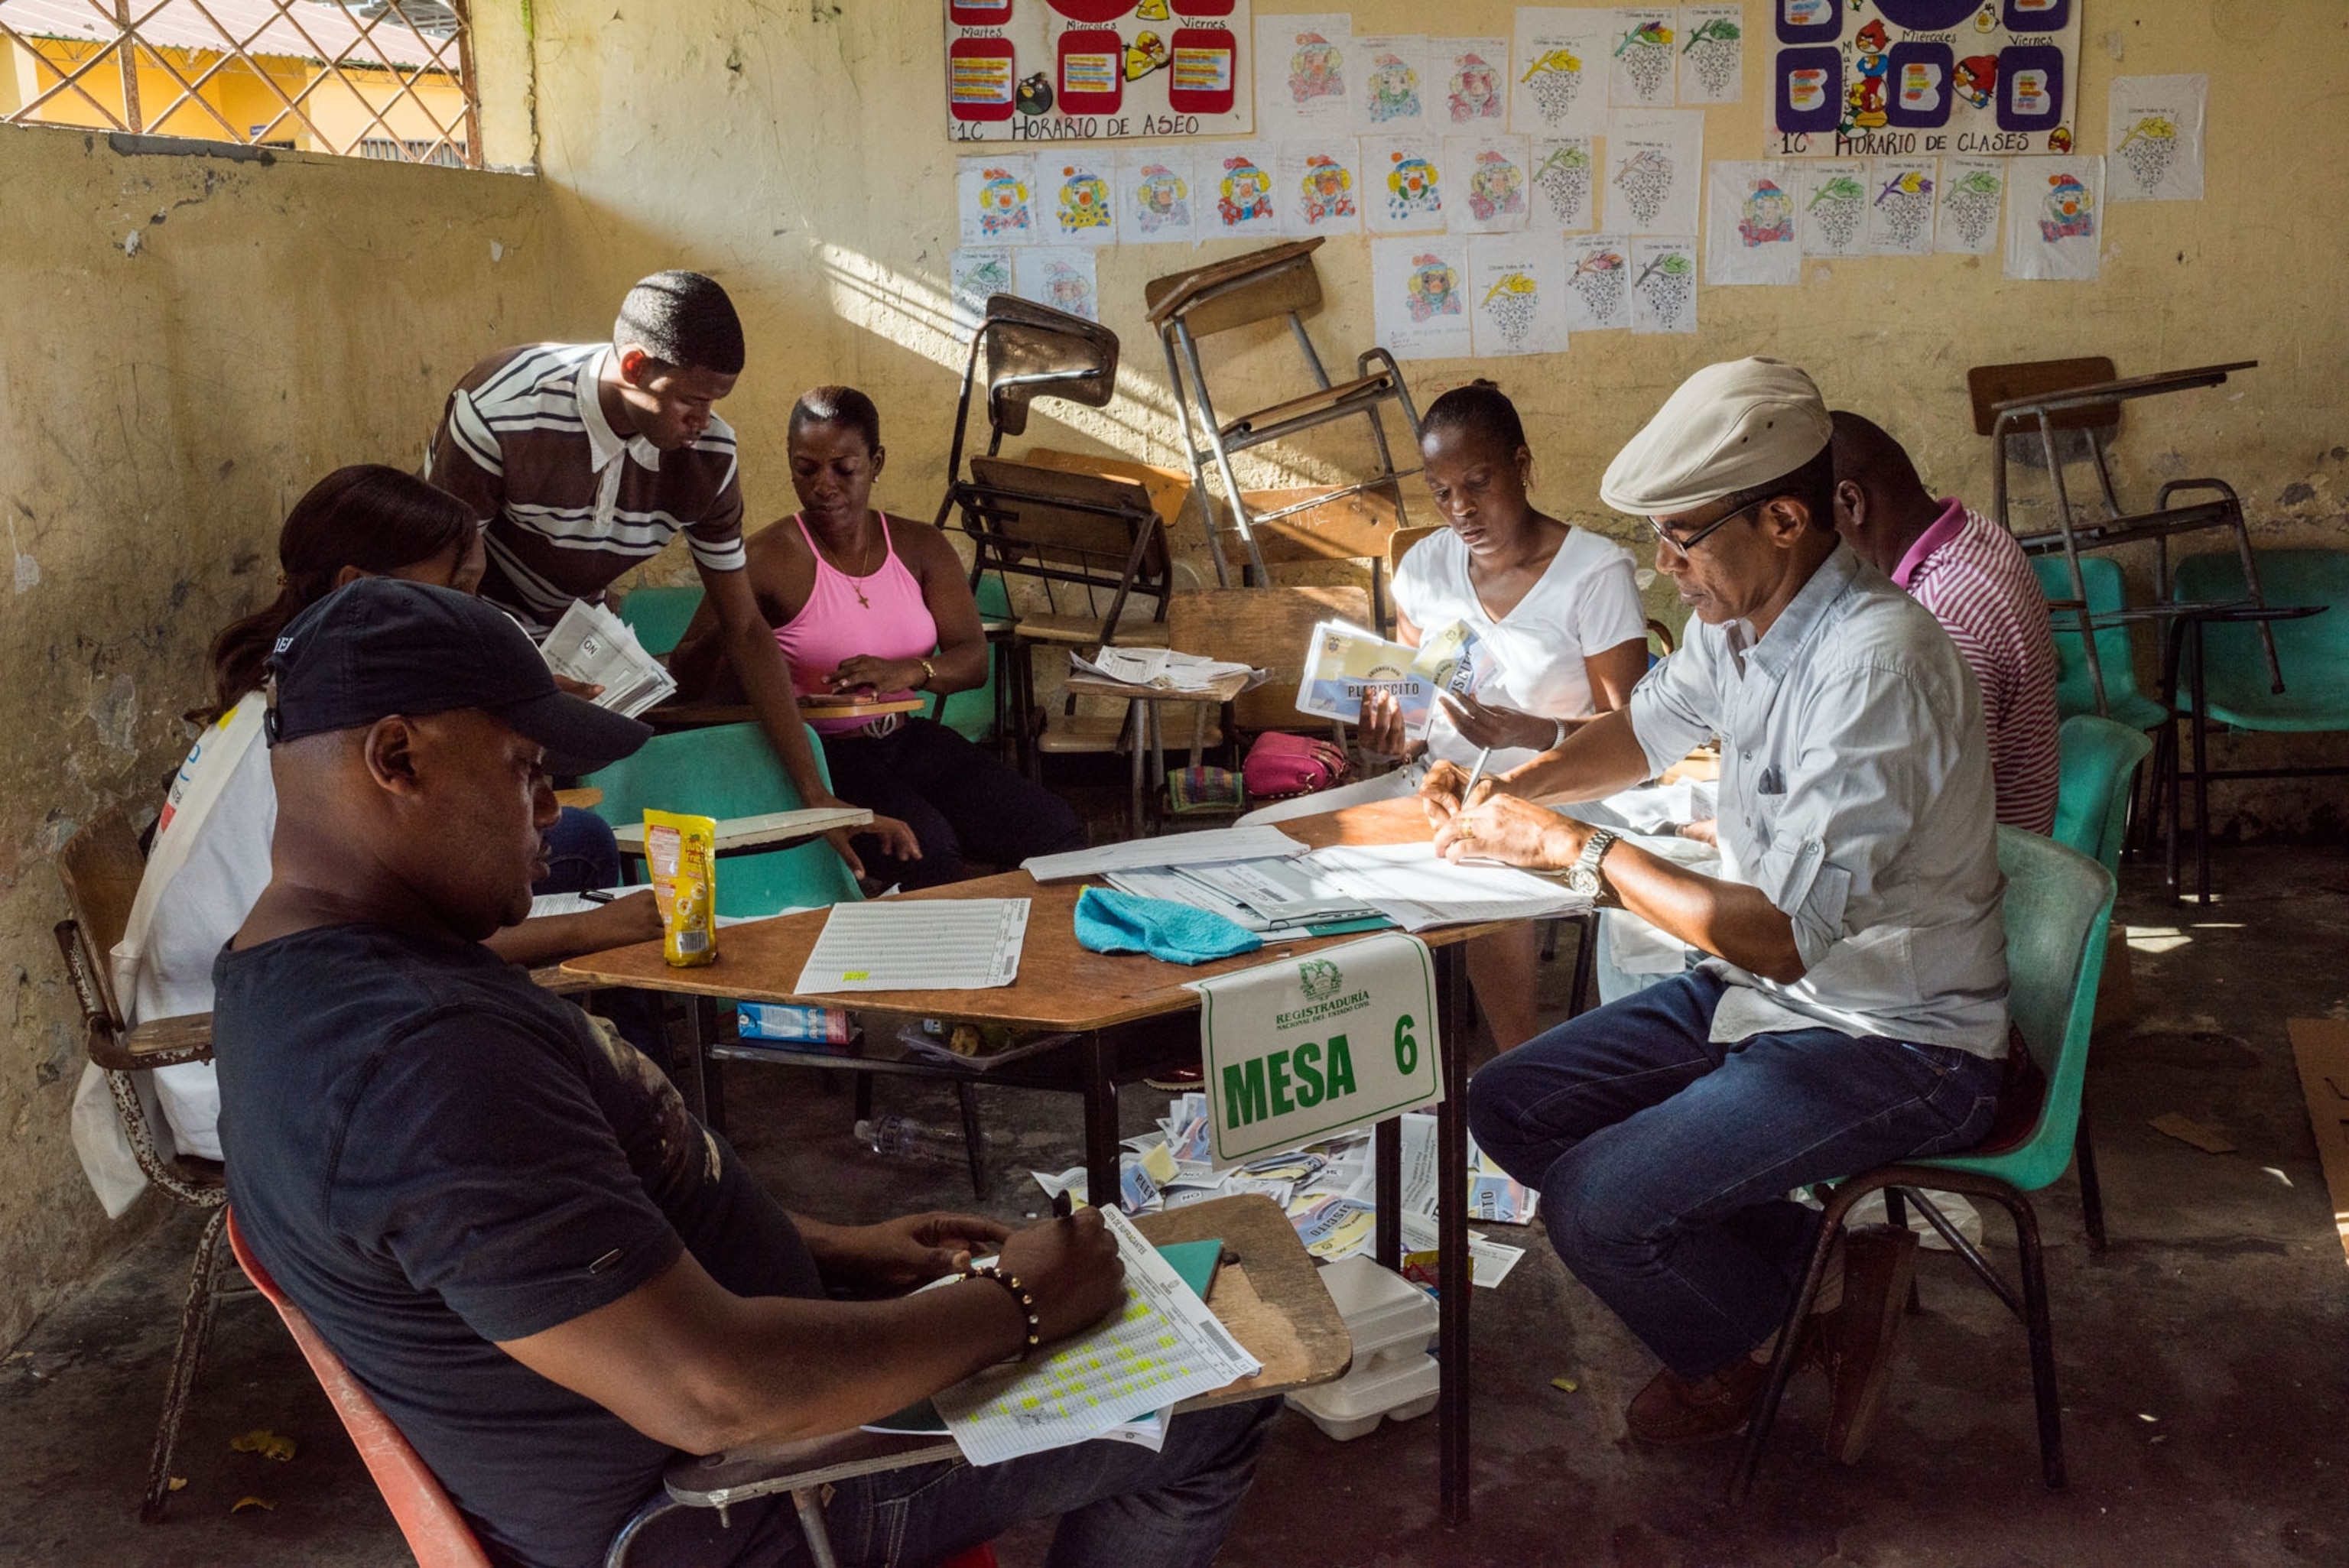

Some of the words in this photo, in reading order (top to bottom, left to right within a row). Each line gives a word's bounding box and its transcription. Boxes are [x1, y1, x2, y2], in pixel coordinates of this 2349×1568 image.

[961, 27, 1002, 37] Martes
[1180, 17, 1226, 29] Viernes
[2009, 34, 2053, 46] Viernes
[1012, 115, 1097, 140] HORARIO
[1107, 118, 1129, 136] DE
[1143, 115, 1199, 135] ASEO
[1836, 129, 1916, 156] HORARIO
[1926, 135, 1947, 151] DE
[1958, 131, 2029, 152] CLASES
[1276, 989, 1369, 1024] REGISTRADURÍA
[1222, 1034, 1356, 1130] MESA
[1395, 1014, 1418, 1075] 6
[1103, 1210, 1117, 1222] LISTA
[1113, 1219, 1122, 1228] DE
